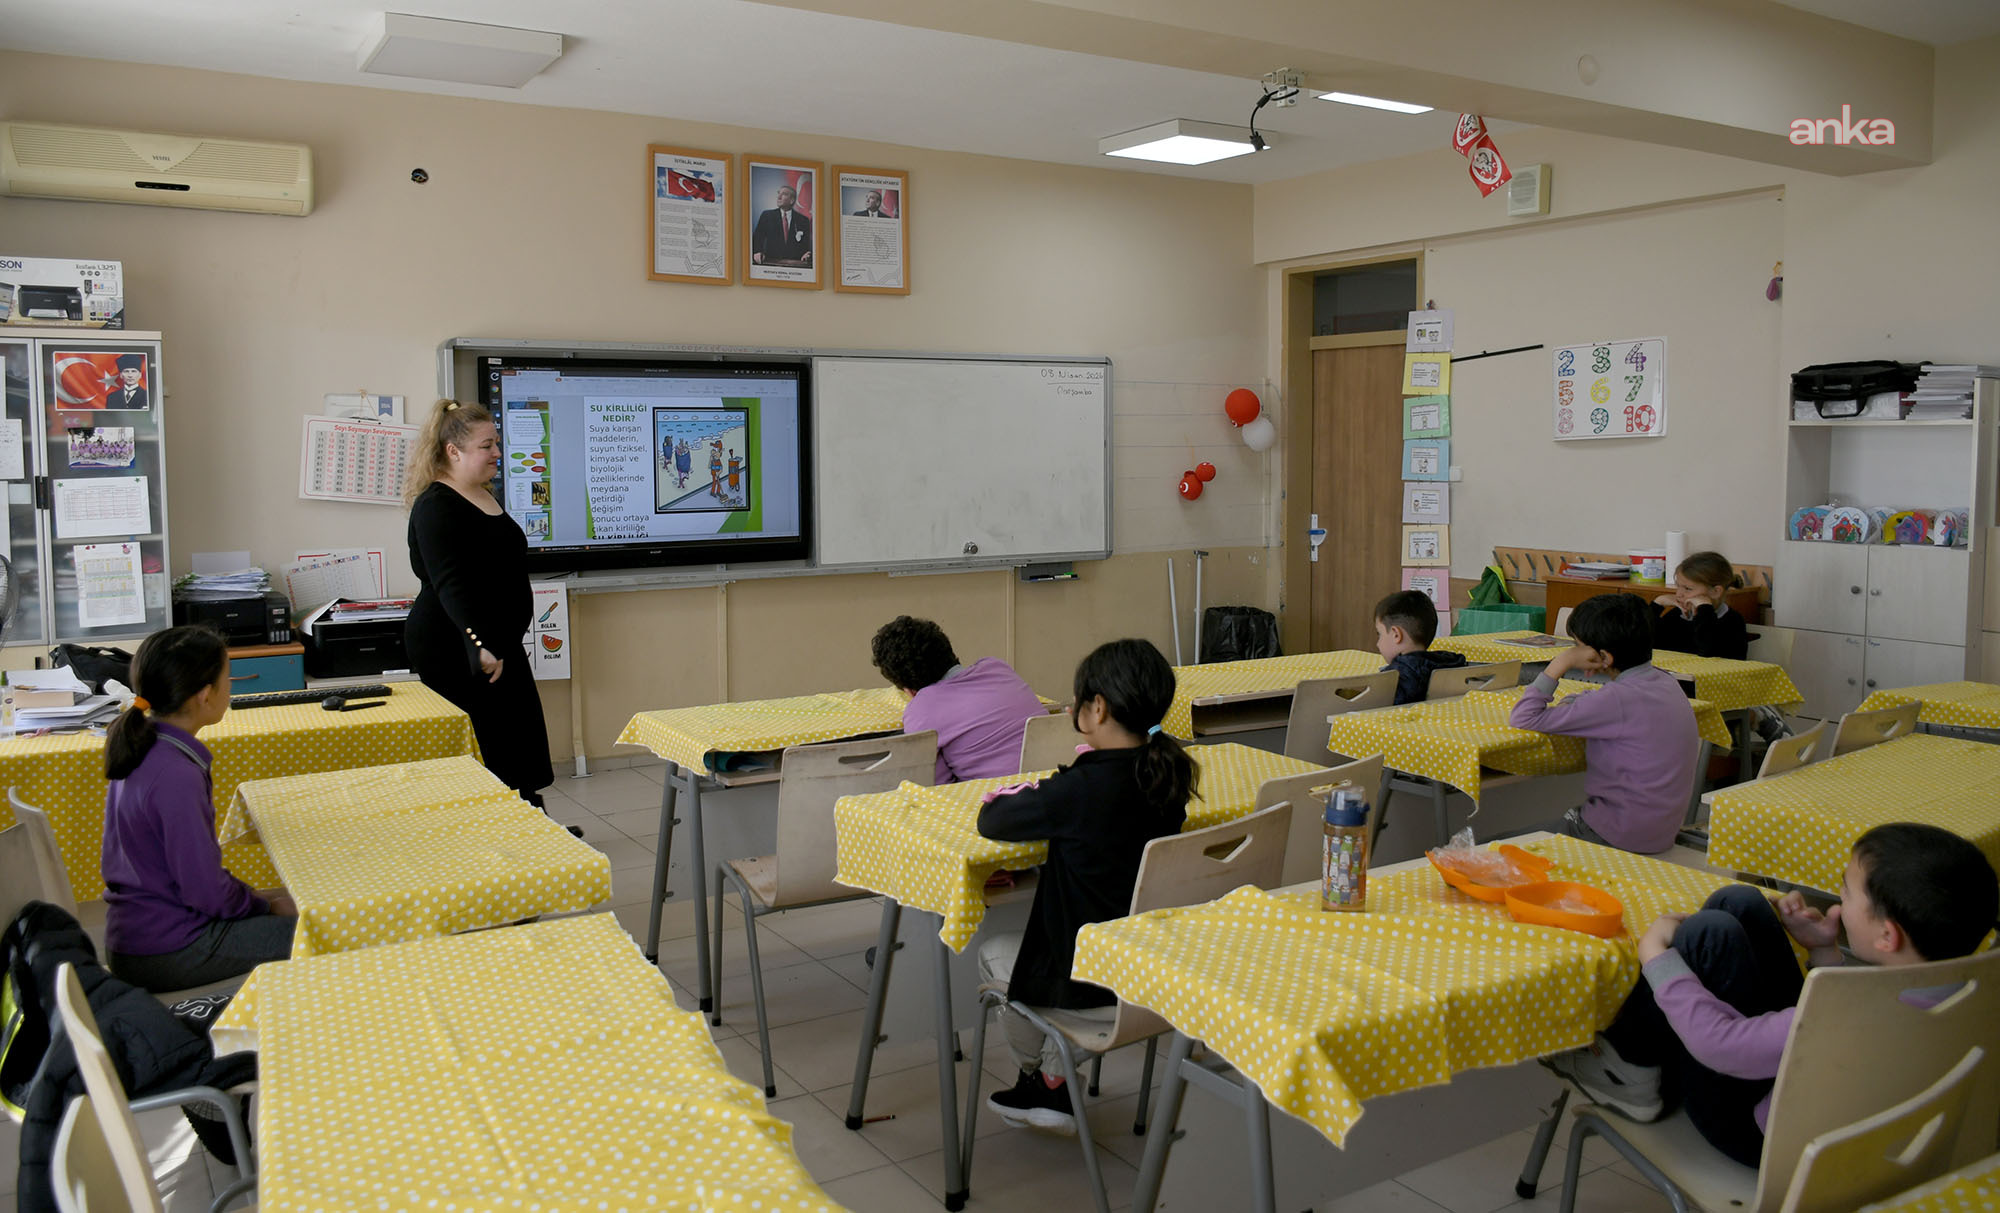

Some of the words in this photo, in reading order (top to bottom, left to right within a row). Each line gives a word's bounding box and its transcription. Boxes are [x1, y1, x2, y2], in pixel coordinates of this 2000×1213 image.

[1558, 350, 1576, 377] 2
[1592, 346, 1611, 374] 3
[1624, 343, 1646, 372] 4
[1041, 368, 1054, 378] 08
[1558, 380, 1574, 406] 5
[1590, 377, 1611, 404] 6
[1624, 375, 1644, 402] 7
[606, 403, 647, 412] KİRLİLİĞİ
[1558, 408, 1574, 434] 8
[1590, 407, 1609, 434] 9
[1624, 404, 1656, 432] 10
[590, 425, 610, 434] Suya
[613, 425, 642, 433] karışan
[590, 434, 639, 443] maddelerin,
[617, 445, 647, 453] fiziksel,
[590, 455, 627, 463] kimyasal
[590, 466, 624, 474] biyolojik
[591, 485, 629, 493] meydana
[591, 495, 625, 504] getirdiği
[592, 505, 623, 514] değişim
[592, 526, 613, 534] çıkan
